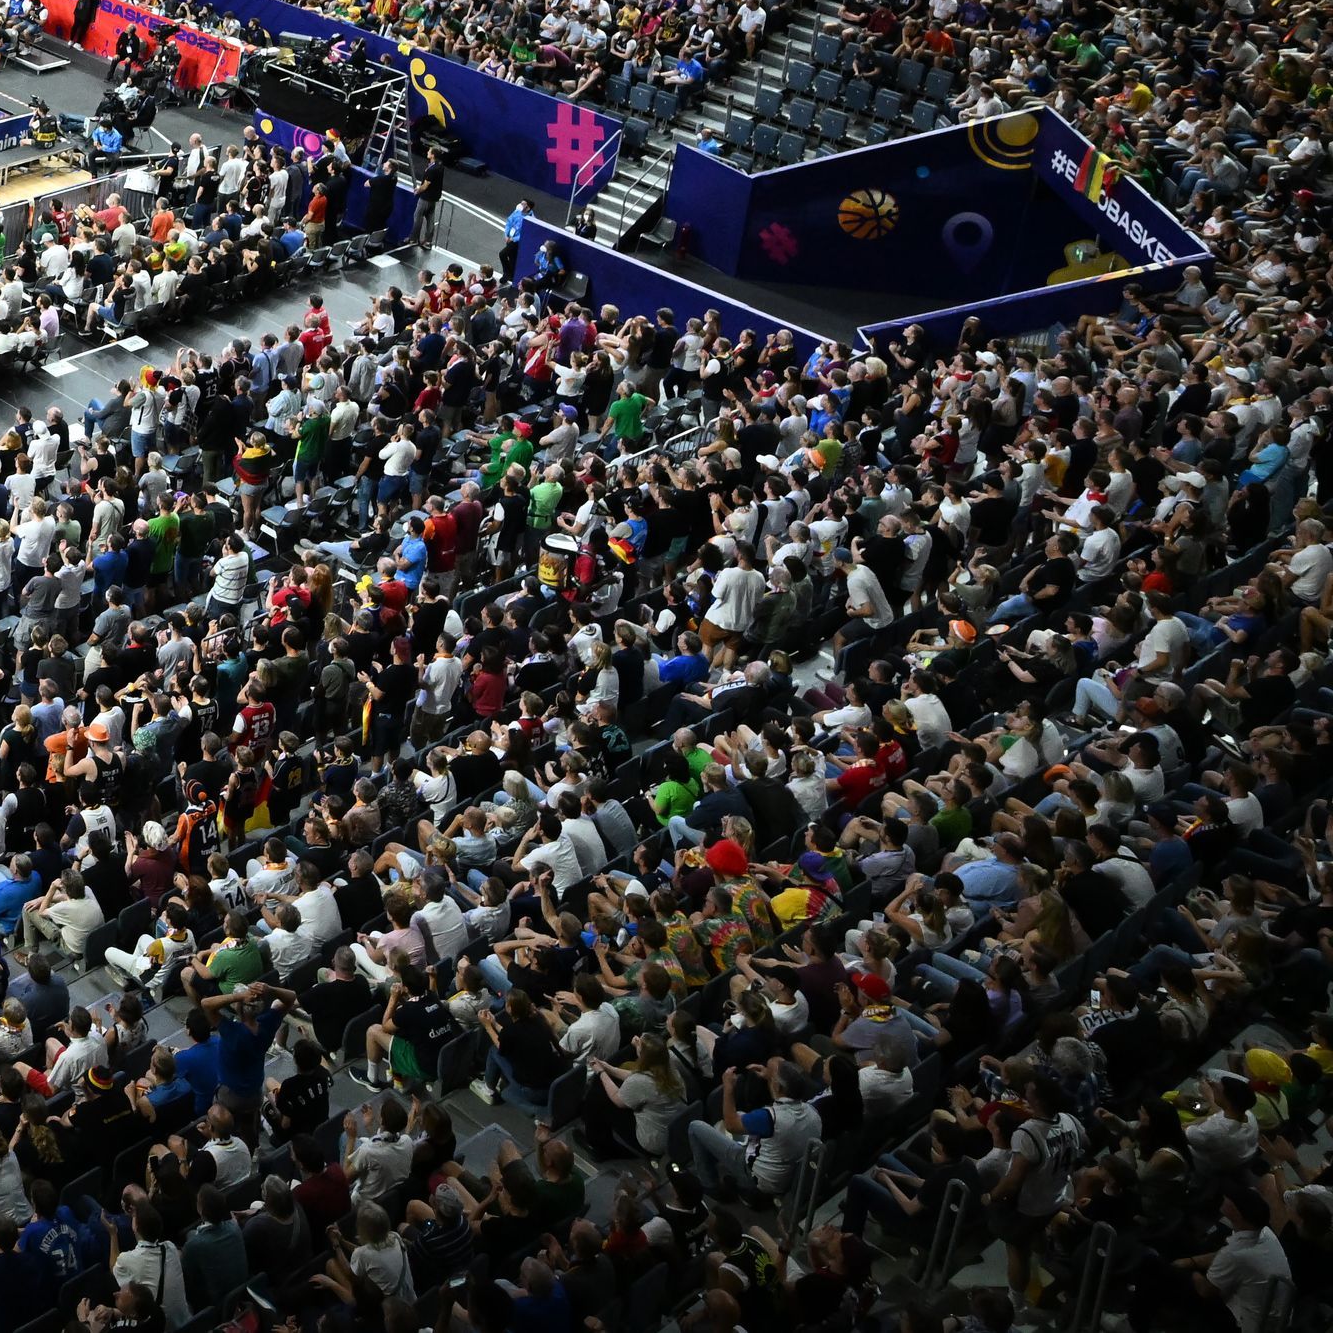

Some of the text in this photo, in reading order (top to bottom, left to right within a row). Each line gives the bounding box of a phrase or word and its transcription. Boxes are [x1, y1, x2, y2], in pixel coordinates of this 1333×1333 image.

[175, 29, 224, 57] 2022
[199, 822, 217, 844] 14
[224, 887, 246, 909] 14
